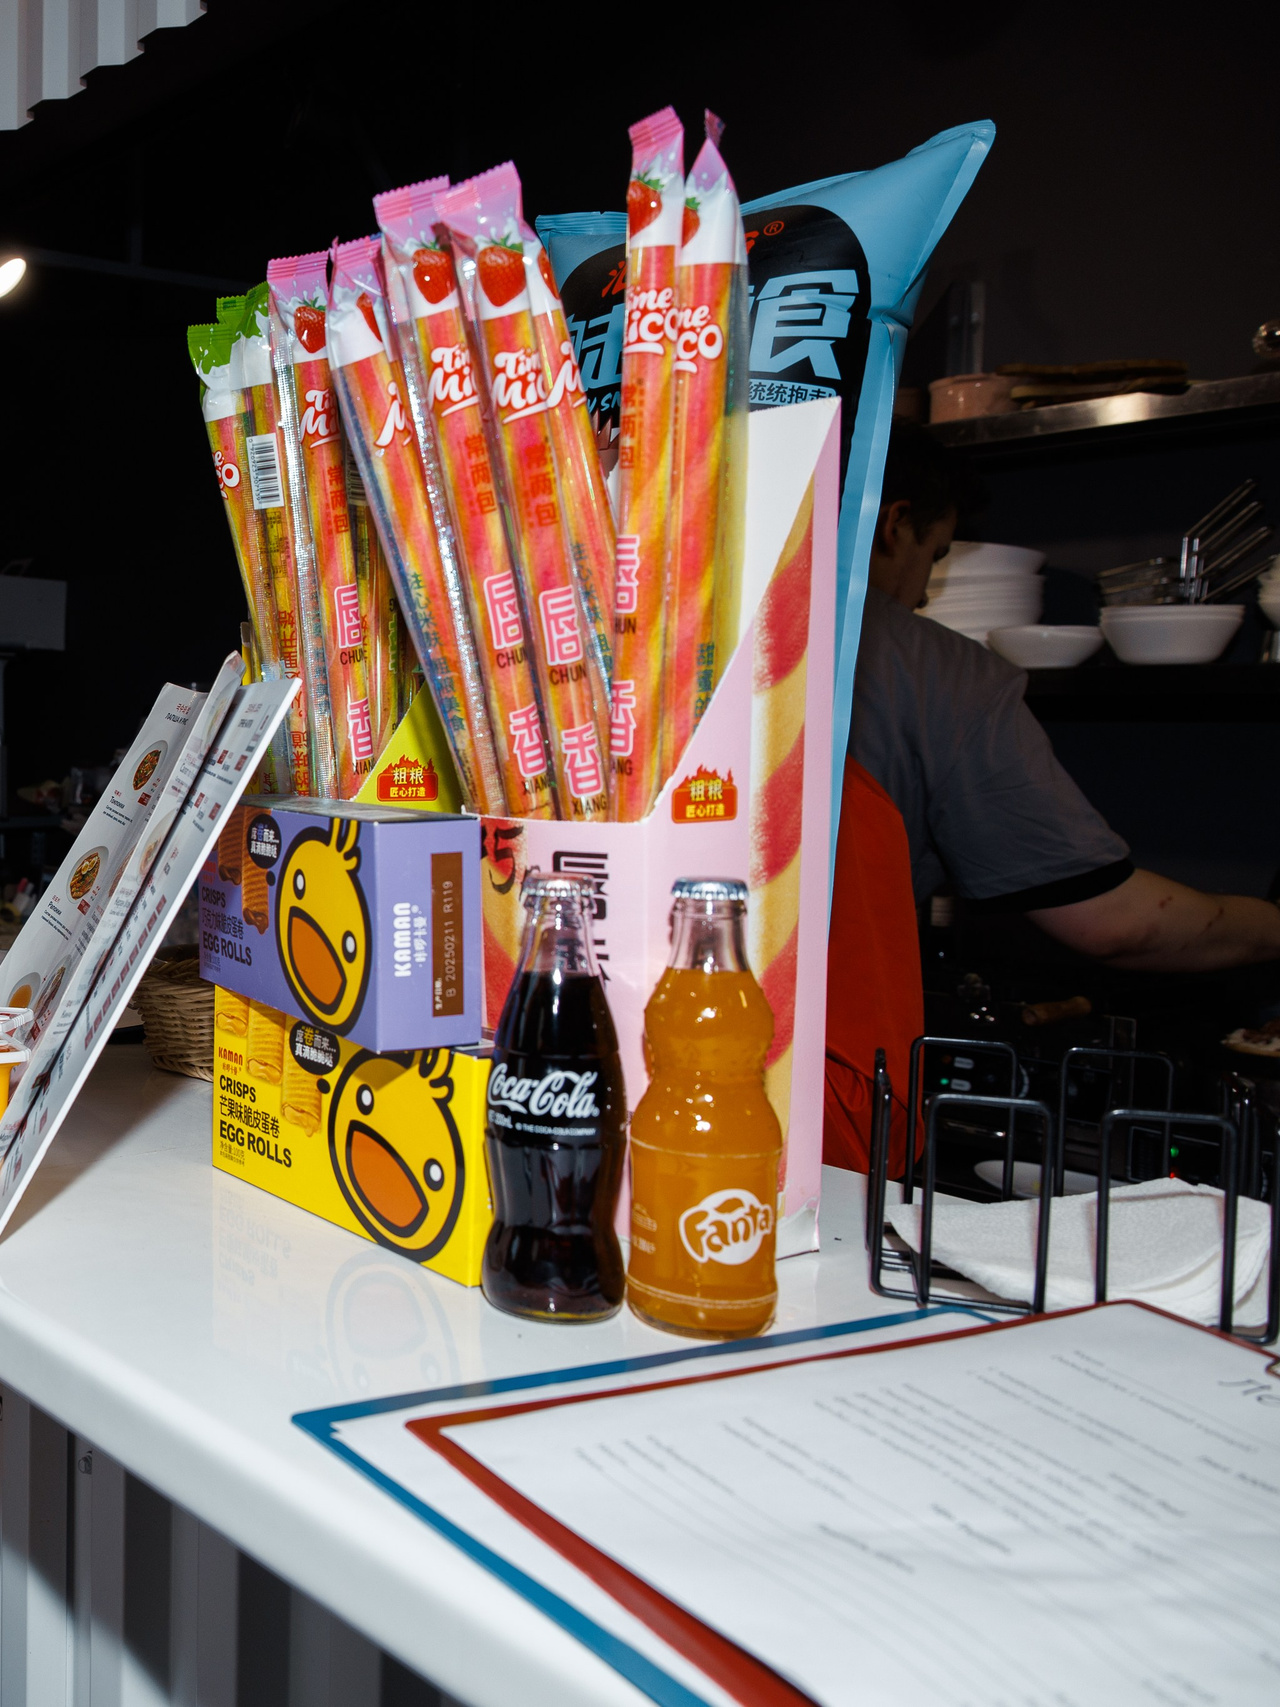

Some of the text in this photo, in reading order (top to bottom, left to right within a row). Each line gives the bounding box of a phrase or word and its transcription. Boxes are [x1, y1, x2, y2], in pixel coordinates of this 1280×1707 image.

[392, 766, 425, 785] 粗粮
[561, 721, 603, 799] 香
[389, 786, 426, 798] 匠心打造
[688, 779, 724, 802] 粗粮
[685, 803, 726, 818] 匠心打造
[201, 886, 226, 909] CRISPS
[442, 880, 454, 914] R119
[202, 931, 220, 953] EGG
[220, 938, 253, 967] ROLLS
[392, 902, 412, 978] KAMAN
[218, 1046, 243, 1066] KAMAN
[219, 1074, 256, 1103] CRISPS
[489, 1064, 598, 1117] Coca-Cola
[219, 1095, 280, 1139] 芒果味脆皮蛋卷
[219, 1120, 245, 1147] EGG
[247, 1135, 292, 1168] ROLLS
[681, 1203, 772, 1260] Fanta
